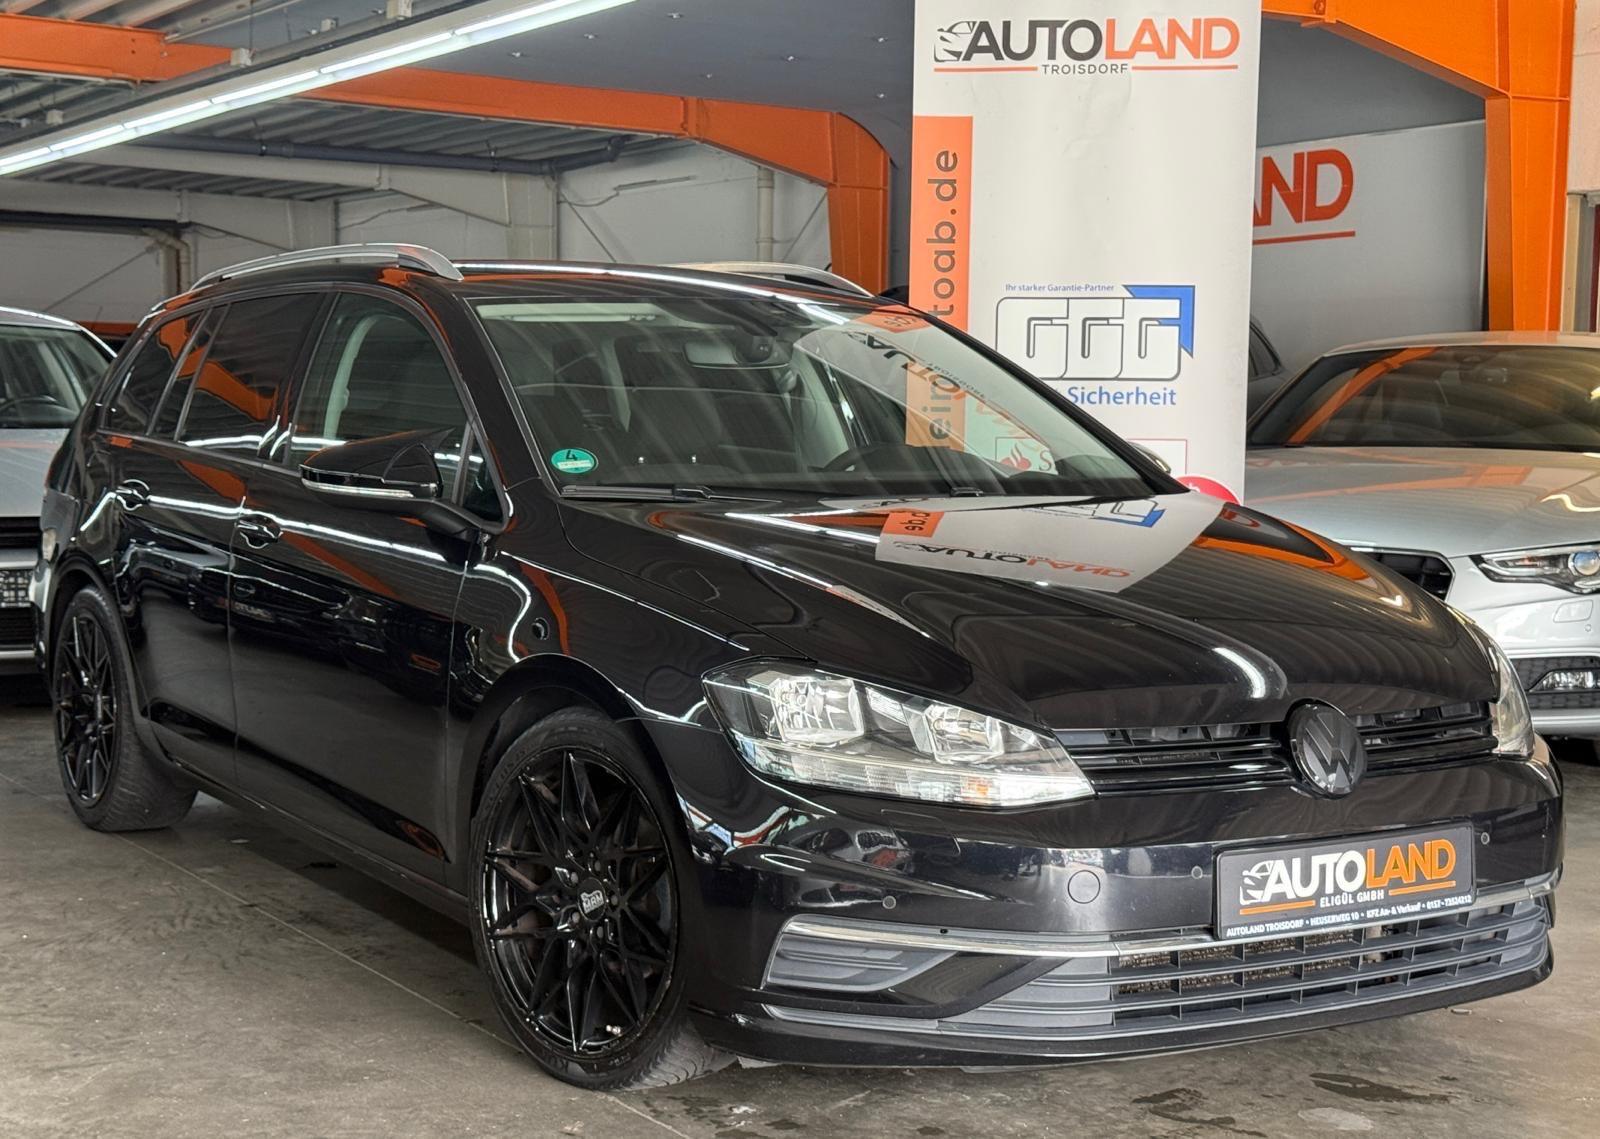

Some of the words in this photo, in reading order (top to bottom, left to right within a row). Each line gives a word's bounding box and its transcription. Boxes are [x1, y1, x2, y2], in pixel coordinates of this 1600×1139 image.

[962, 17, 1240, 62] AUTOLAND
[1041, 63, 1129, 75] TROISDORF
[1253, 148, 1354, 228] ND
[1005, 284, 1017, 292] Ihr
[1018, 284, 1046, 292] starker
[1047, 284, 1115, 292] Garantie-Partner
[1067, 386, 1178, 406] Sicherheit
[1262, 839, 1456, 903] AUTOLAND
[1357, 889, 1385, 901] GMBH
[1226, 924, 1265, 937] AUTOLAND
[1265, 918, 1304, 932] TROISDORF
[1351, 911, 1360, 920] 10
